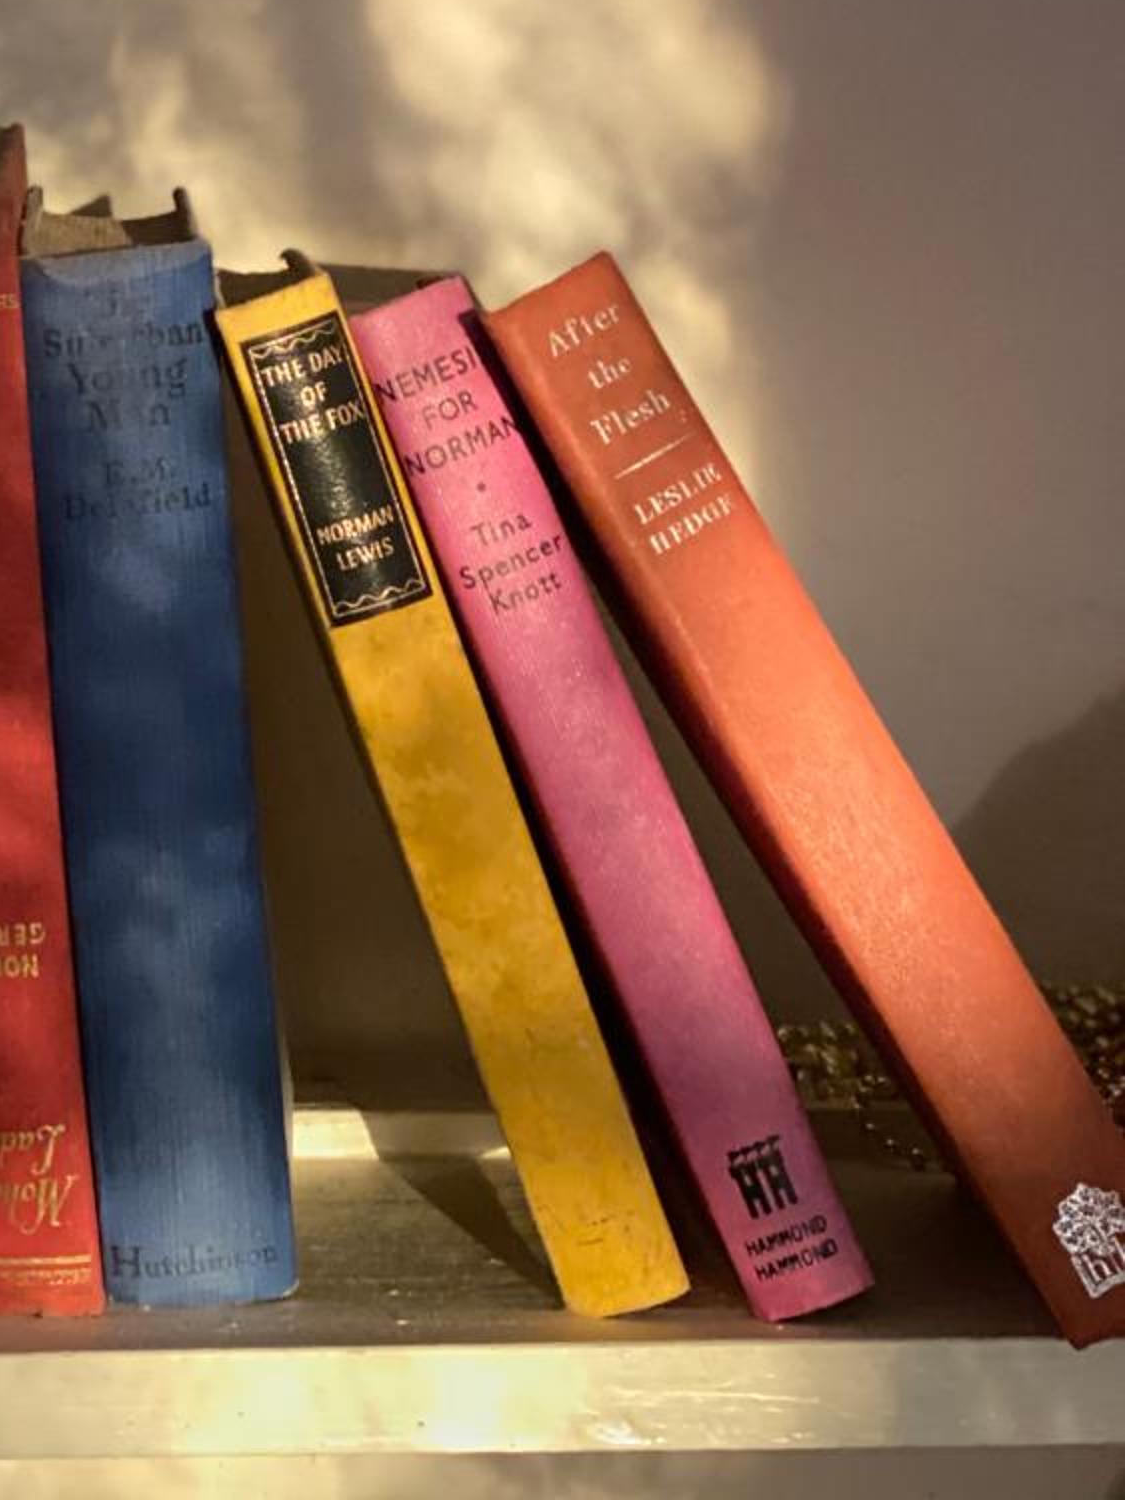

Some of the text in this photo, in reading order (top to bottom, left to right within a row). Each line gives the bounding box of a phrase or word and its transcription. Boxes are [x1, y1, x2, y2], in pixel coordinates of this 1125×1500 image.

[548, 304, 620, 358] After
[261, 346, 345, 388] THE DAY
[374, 346, 478, 402] NEMESI
[587, 358, 632, 390] the
[300, 381, 329, 406] OF
[422, 391, 478, 431] FOR
[279, 400, 364, 444] THE FOX
[590, 389, 672, 445] Flesh
[404, 414, 522, 478] NORMAN
[633, 462, 723, 526] LESLIE
[316, 505, 395, 545] NORMAN
[469, 513, 532, 548] Tina
[336, 538, 394, 571] LEWIS
[459, 534, 563, 589] Spencer
[490, 572, 562, 614] Knott
[745, 1214, 828, 1257] HAMMOND
[754, 1238, 839, 1281] HAMMOND
